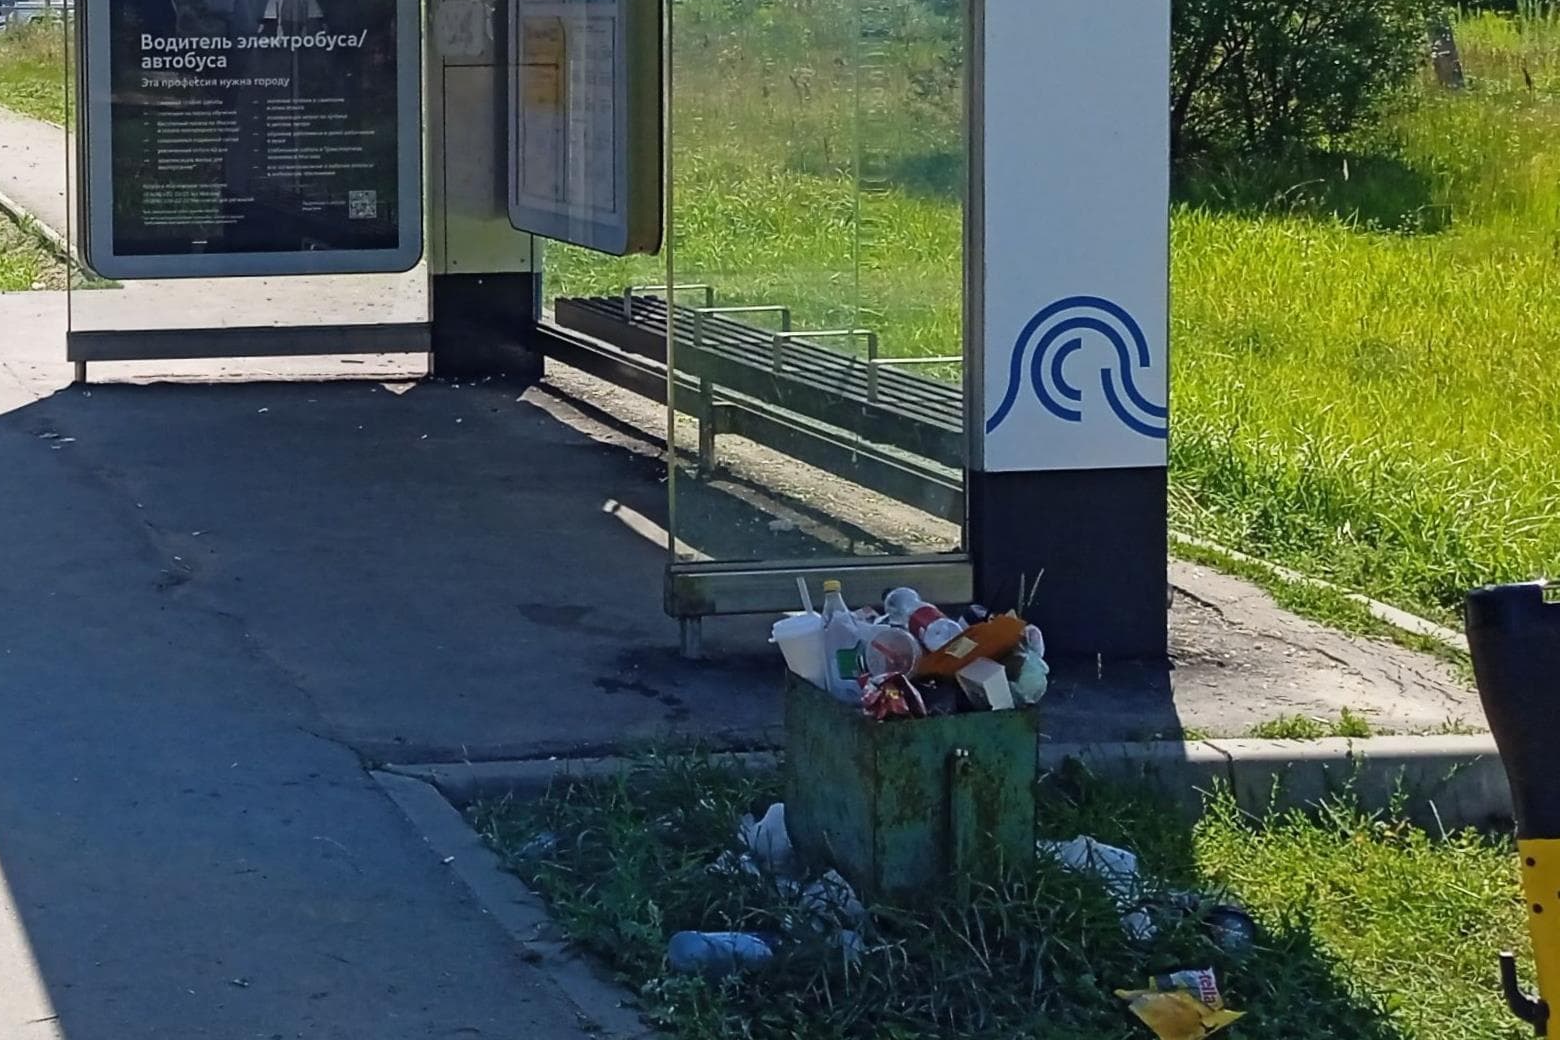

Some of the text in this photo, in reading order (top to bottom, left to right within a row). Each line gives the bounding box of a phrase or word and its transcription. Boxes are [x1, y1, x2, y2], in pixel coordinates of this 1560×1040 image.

[141, 29, 368, 53] Водитель электробуса/
[141, 51, 228, 72] автобуса
[141, 76, 290, 89] Эта профессия нужна городу
